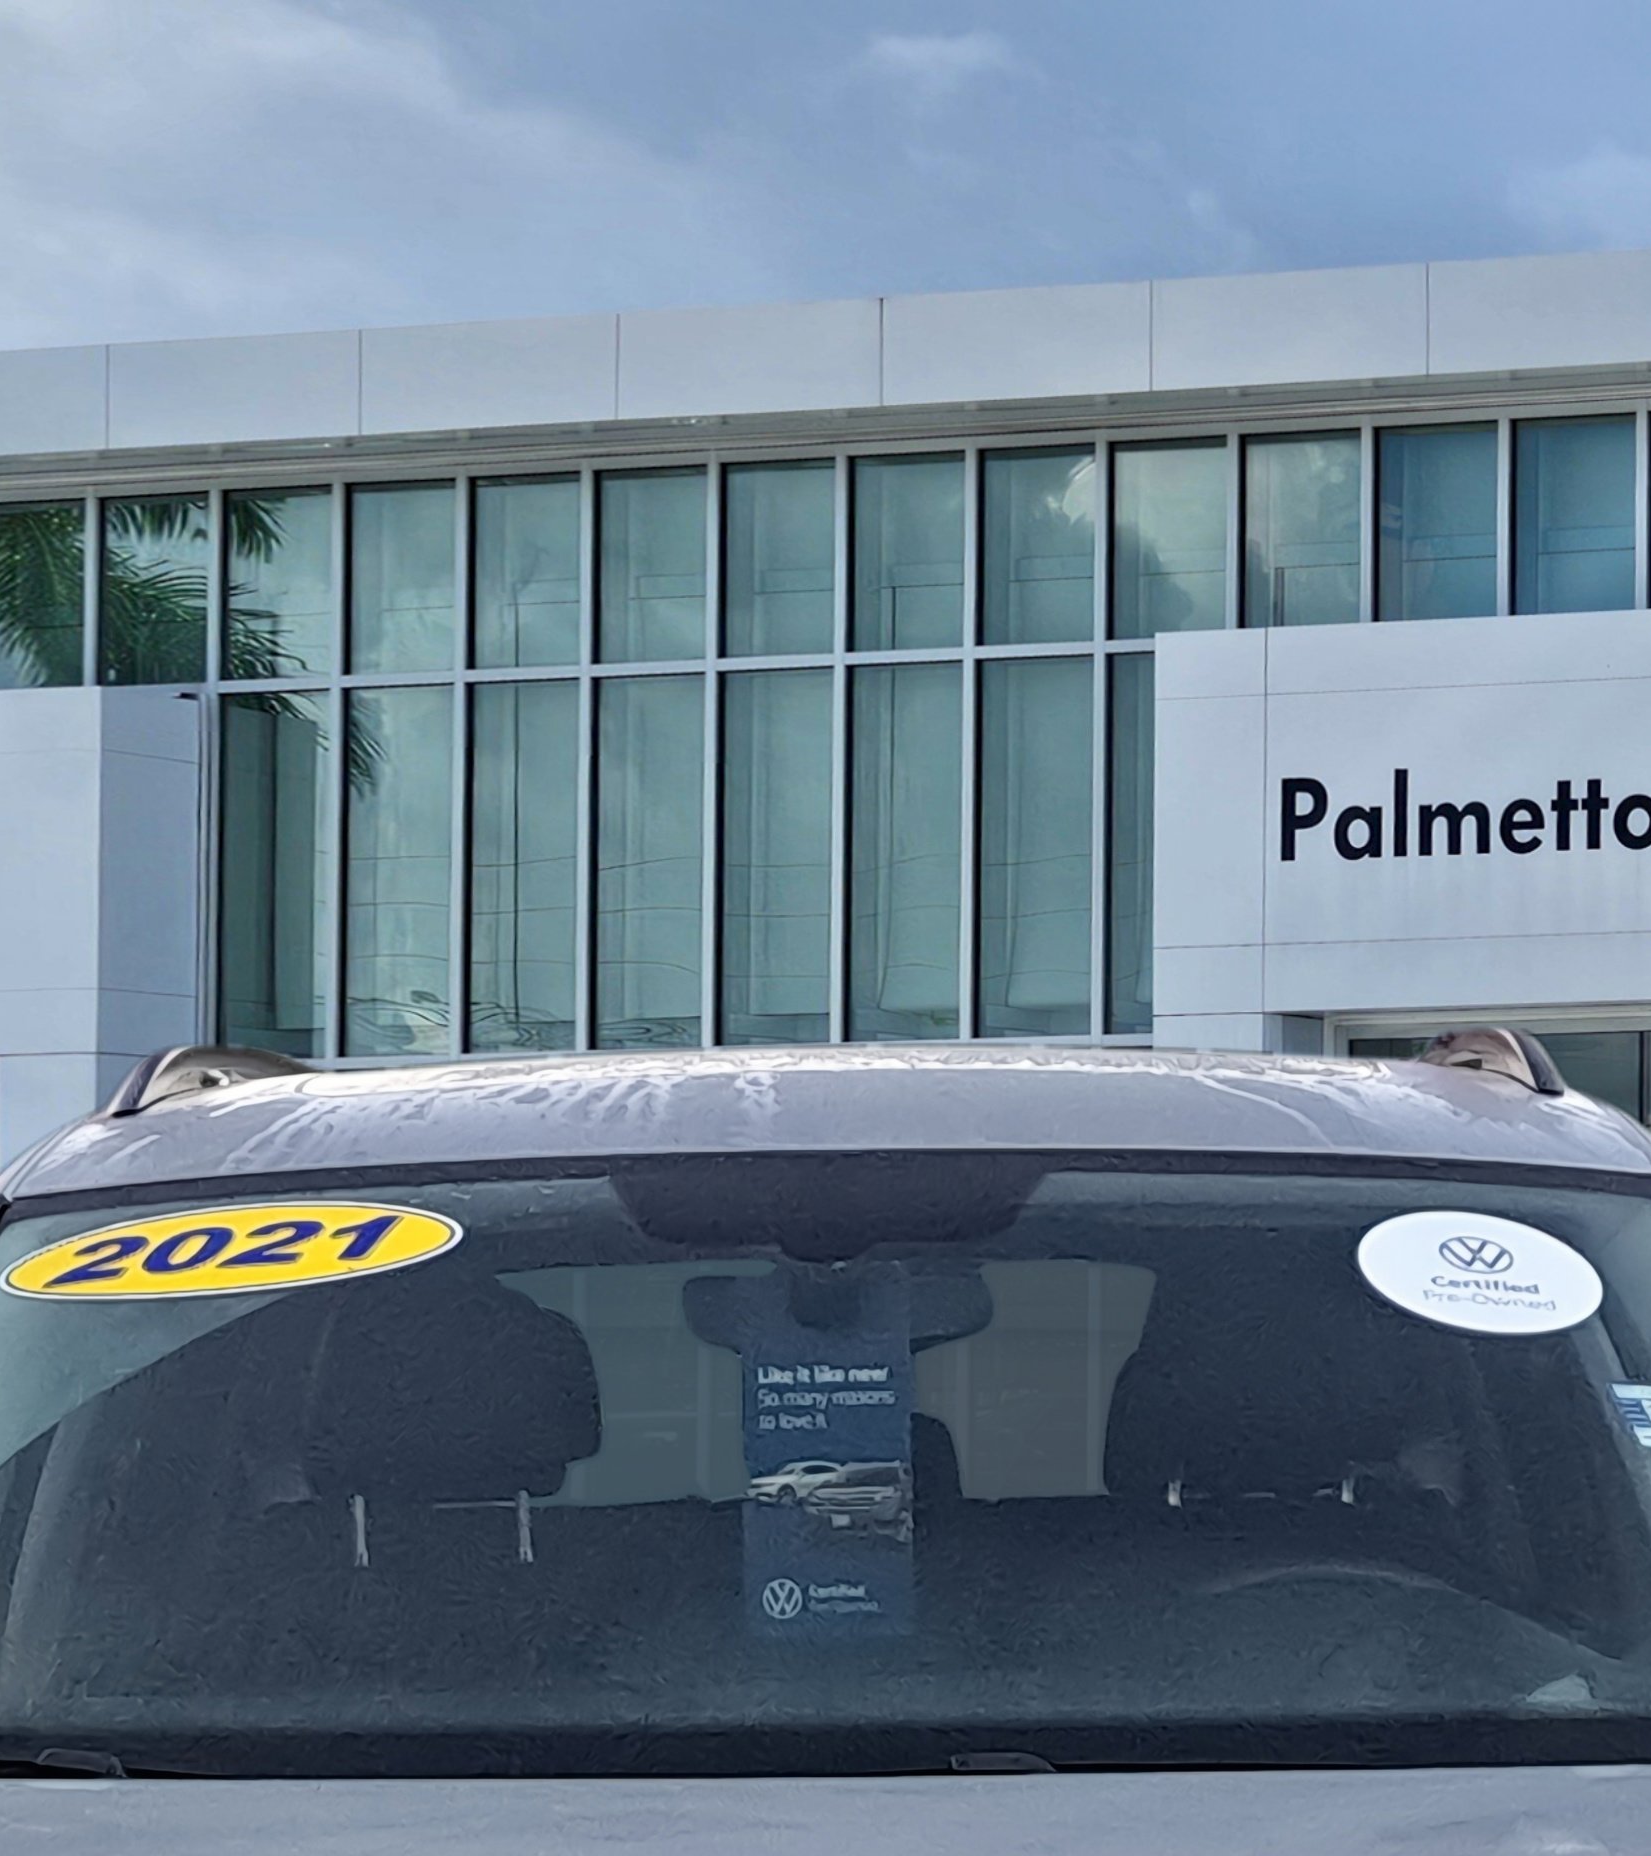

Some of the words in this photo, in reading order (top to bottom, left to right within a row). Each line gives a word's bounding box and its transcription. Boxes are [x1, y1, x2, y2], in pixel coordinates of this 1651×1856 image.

[43, 1214, 405, 1289] 2021
[1430, 1275, 1540, 1295] Certified
[1422, 1289, 1556, 1311] Pre-Owned
